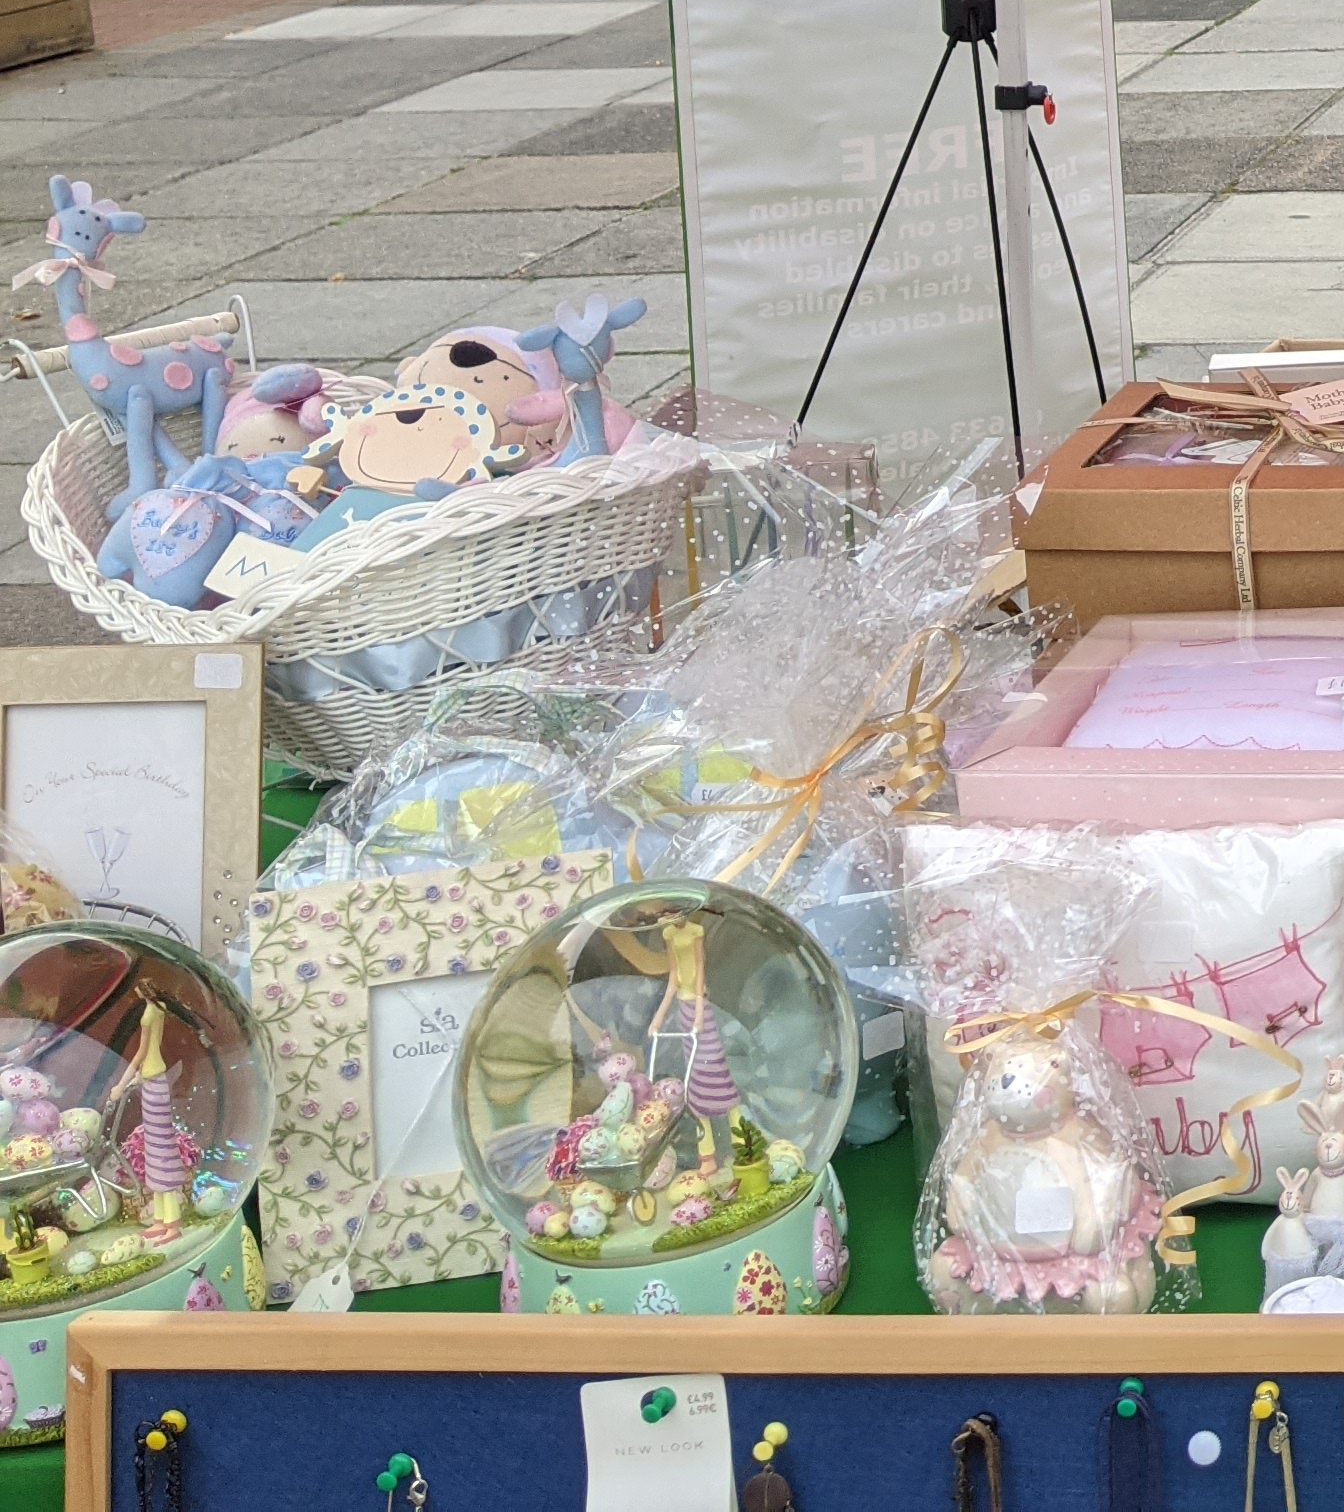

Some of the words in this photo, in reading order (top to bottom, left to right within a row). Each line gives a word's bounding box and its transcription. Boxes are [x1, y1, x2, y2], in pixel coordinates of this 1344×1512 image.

[1233, 514, 1245, 545] Herbal
[1235, 546, 1247, 587] Company
[1240, 588, 1251, 603] Ltd
[81, 761, 130, 781] Special
[134, 764, 190, 800] Birthday
[392, 1039, 456, 1060] Collec
[688, 1392, 714, 1405] £4.99
[615, 1445, 652, 1457] NEW
[660, 1440, 704, 1454] LOOK
